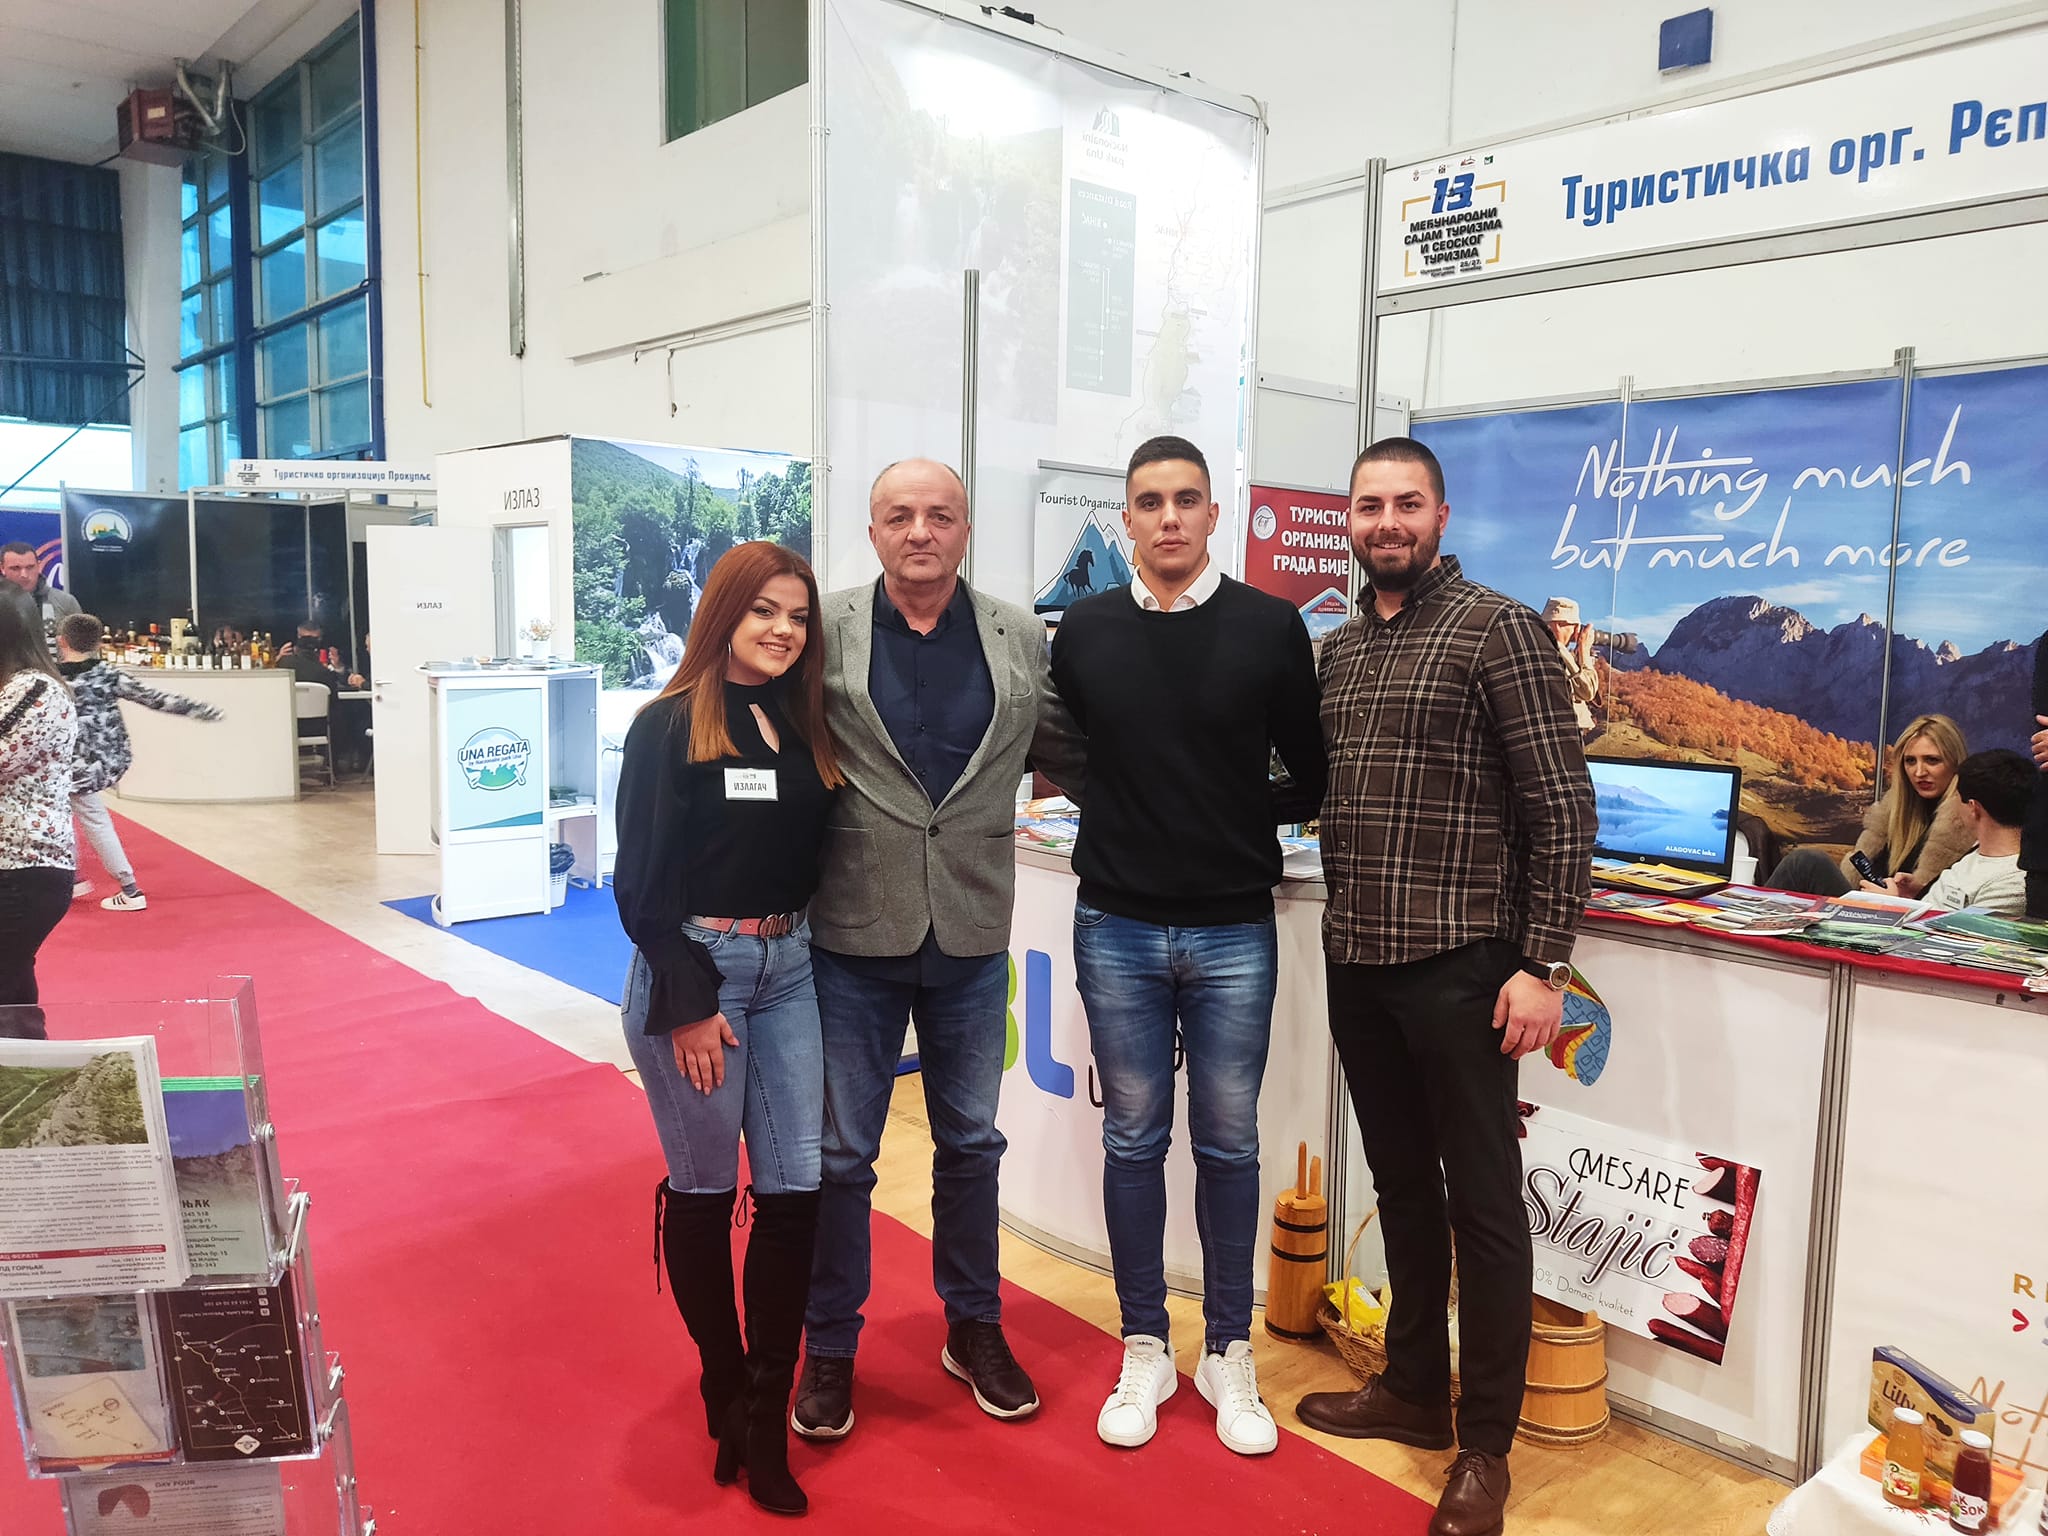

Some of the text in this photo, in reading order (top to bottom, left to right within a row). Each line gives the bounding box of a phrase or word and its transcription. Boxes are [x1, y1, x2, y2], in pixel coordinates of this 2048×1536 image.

[1563, 147, 1810, 228] Туристичка
[1829, 127, 1926, 184] орг.
[1432, 173, 1475, 214] 13
[1404, 219, 1503, 245] САЈАМ ТУРИЗМА
[1420, 234, 1484, 254] И СЕОСКОГ
[1423, 247, 1479, 266] ТУРИЗМА
[1575, 404, 1972, 521] Nothing much
[274, 469, 324, 480] Туристичка
[504, 487, 541, 511] ИЗЛАЗ
[1039, 491, 1078, 507] Tourist
[1648, 497, 1800, 570] much
[1824, 537, 1971, 568] more
[1273, 554, 1316, 576] ГРАДА
[460, 741, 529, 762] UNA REGATA
[733, 782, 767, 791] ИЗЛАГАЧ
[1533, 1267, 1553, 1285] 0%
[1598, 1291, 1634, 1317] kvalitet
[1882, 1380, 1916, 1410] Lilly
[1960, 1505, 1985, 1516] SOK
